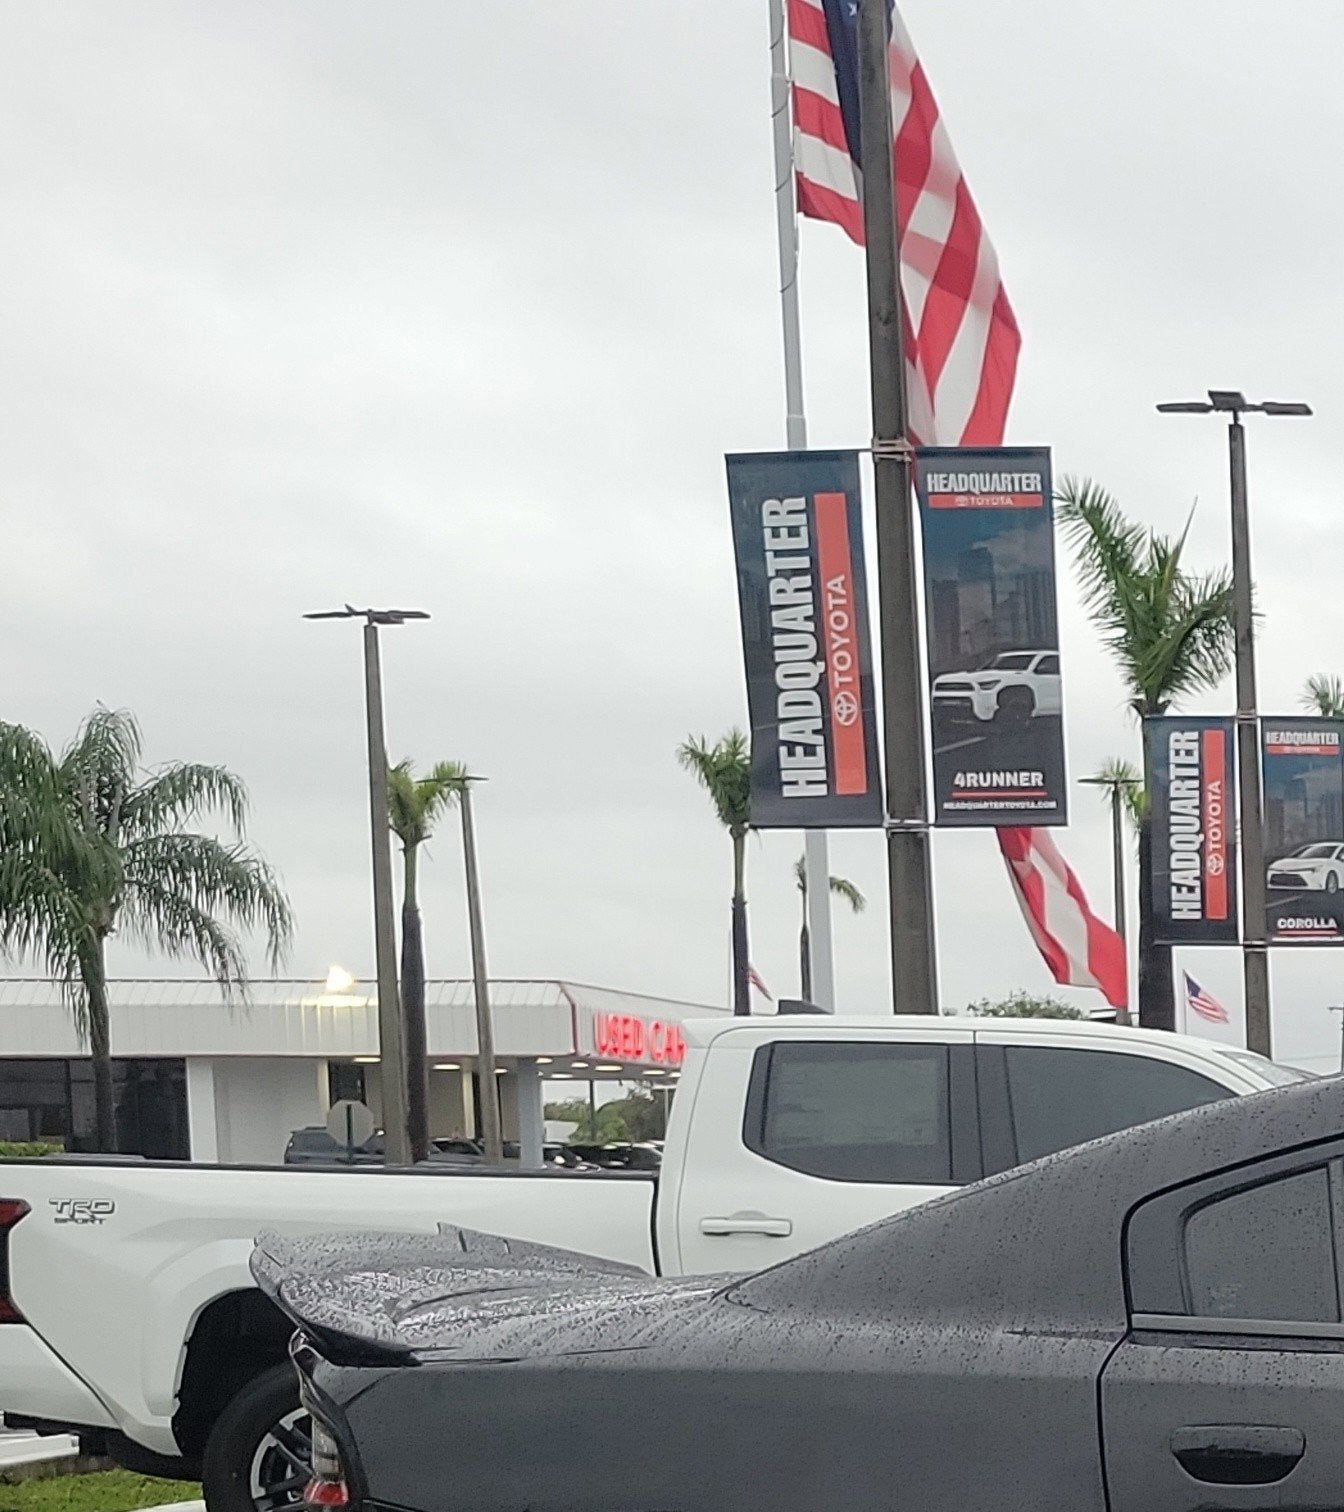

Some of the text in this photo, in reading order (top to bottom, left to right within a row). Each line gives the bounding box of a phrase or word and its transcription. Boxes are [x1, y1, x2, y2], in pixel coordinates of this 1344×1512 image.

[927, 472, 1042, 495] HEADQUARTER
[970, 496, 1014, 506] TOYOTA
[826, 573, 854, 688] TOYOTA
[762, 496, 829, 798] HEADQUARTER
[1266, 731, 1340, 746] HEADQUARTER
[953, 771, 1044, 788] 4RUNNER
[1169, 730, 1203, 921] HEADQUARTER
[1208, 781, 1223, 854] TOYOTA
[1277, 917, 1337, 929] COROLLA
[594, 1013, 644, 1058] USED
[49, 1198, 115, 1219] TRD
